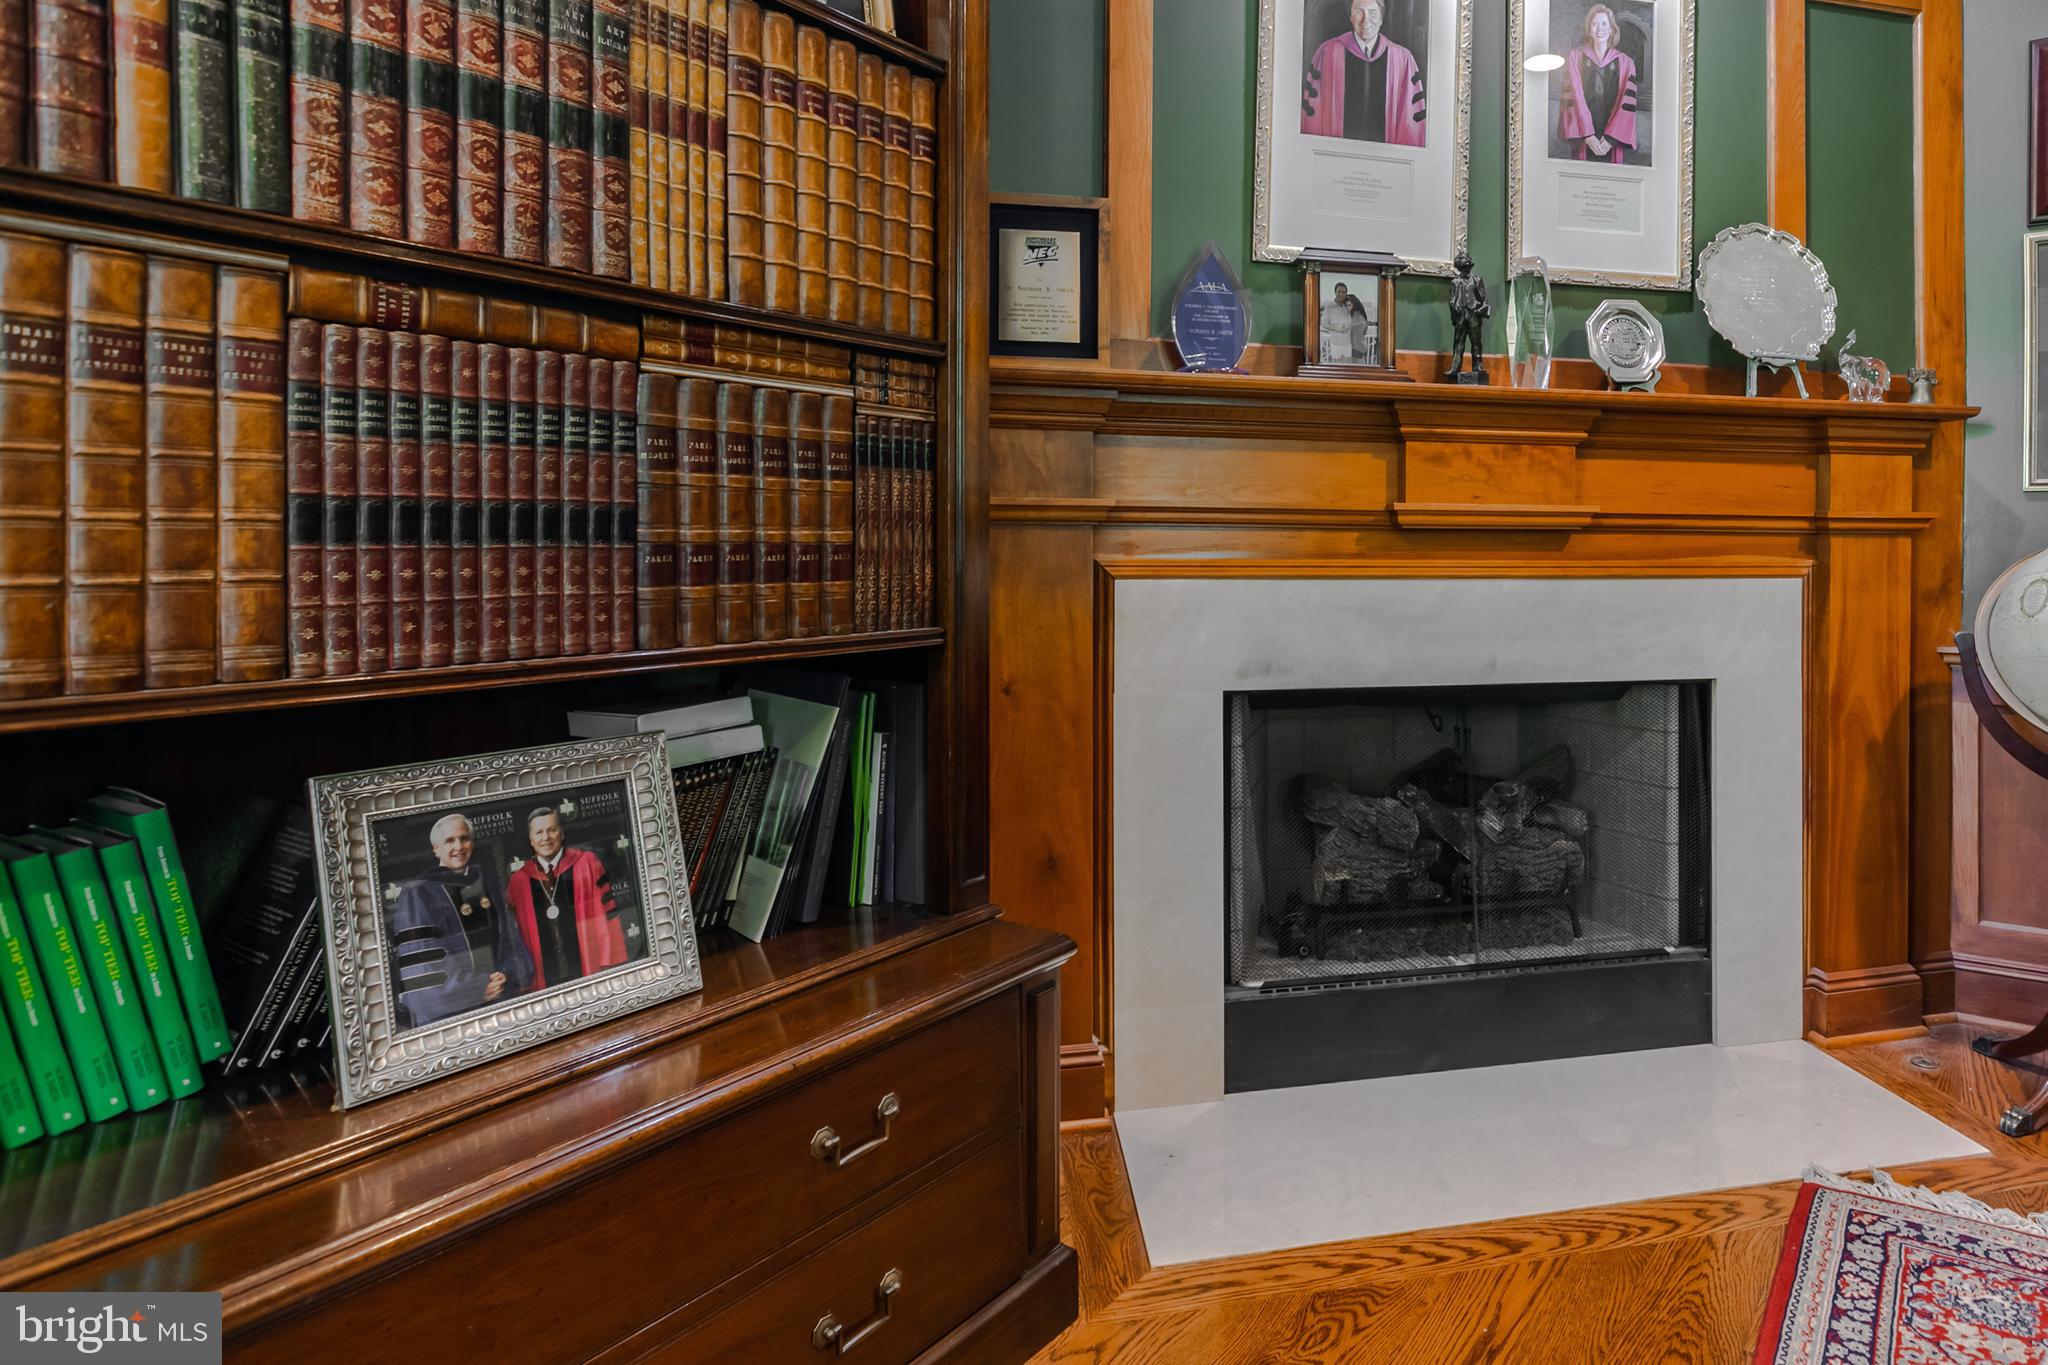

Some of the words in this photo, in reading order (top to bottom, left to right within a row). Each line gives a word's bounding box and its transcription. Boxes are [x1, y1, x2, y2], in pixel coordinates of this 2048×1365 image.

[564, 8, 585, 23] ART
[606, 25, 625, 39] ART
[20, 338, 39, 349] OF
[103, 348, 119, 358] OF
[178, 354, 193, 363] OF
[249, 361, 263, 369] OF
[580, 792, 619, 806] SUFFOLK
[473, 820, 513, 831] NIVERSITY
[476, 826, 514, 839] OSTON
[166, 878, 181, 904] TOP
[174, 905, 191, 937] TIER
[134, 913, 150, 939] TOP
[142, 939, 159, 972] TIER
[55, 926, 71, 953] TOP
[64, 954, 82, 988] TIER
[95, 919, 111, 946] TOP
[104, 947, 121, 981] TIER
[7, 937, 23, 965] TOP
[16, 966, 35, 1000] TIER
[275, 986, 286, 1003] TO
[308, 982, 321, 996] TO
[260, 1003, 279, 1032] KNOW
[294, 996, 313, 1025] KNOW
